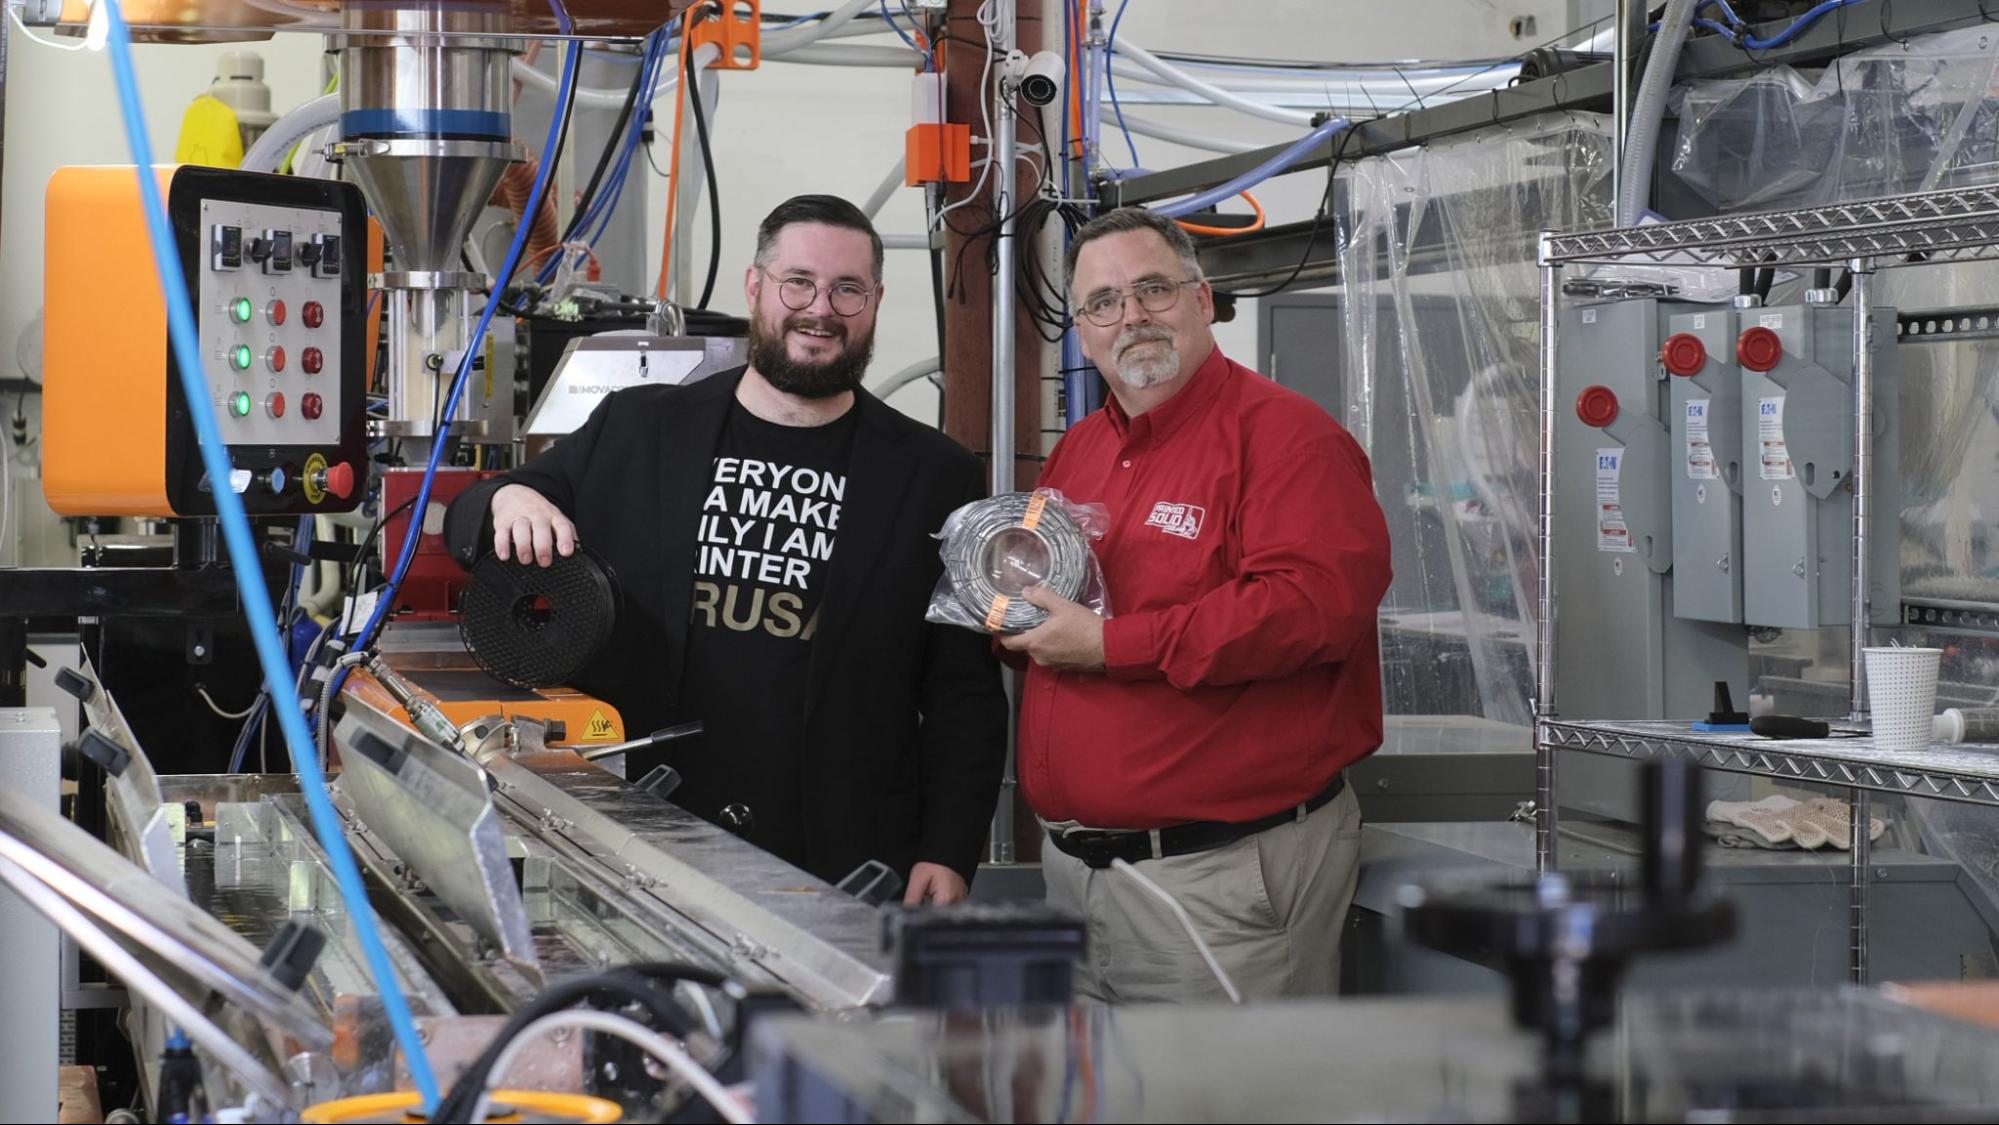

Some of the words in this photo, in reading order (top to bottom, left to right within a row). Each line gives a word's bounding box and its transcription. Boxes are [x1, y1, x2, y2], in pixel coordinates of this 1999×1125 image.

[713, 457, 846, 501] ERYON
[703, 486, 728, 512] A
[739, 488, 842, 530] MAKE
[1148, 512, 1182, 526] SOLID
[697, 515, 756, 546] ILY
[763, 522, 775, 550] I
[780, 528, 835, 561] AM
[694, 545, 811, 590] INTER
